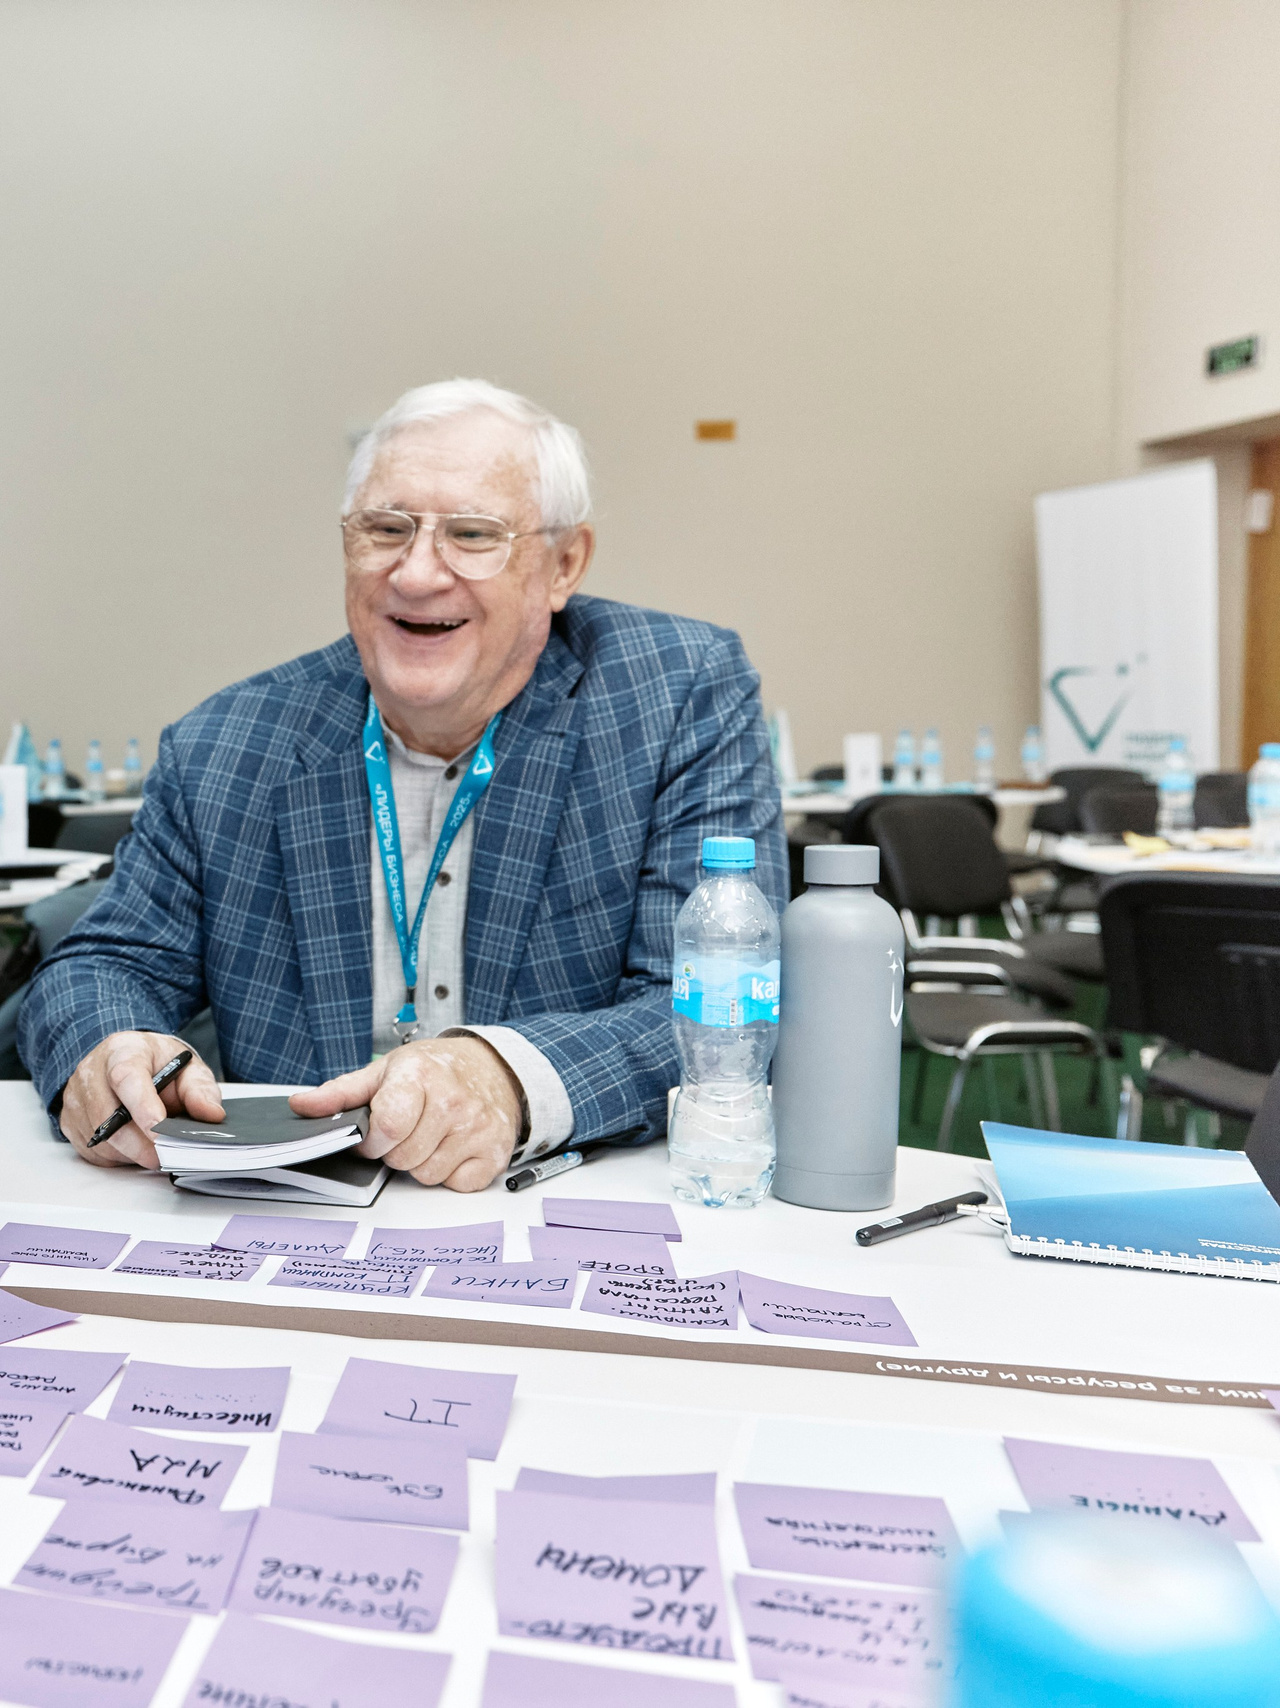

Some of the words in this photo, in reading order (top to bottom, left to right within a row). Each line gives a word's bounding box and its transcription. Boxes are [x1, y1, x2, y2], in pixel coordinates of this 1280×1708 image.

[375, 783, 395, 852] «ЛИДЕРЫ
[385, 852, 404, 923] БИЗНЕСА
[246, 1239, 345, 1255] ДИЛЕРЫ
[282, 1266, 367, 1280] КОМПАНИИ
[290, 1280, 410, 1294] КРУПНЫЕ
[451, 1275, 569, 1292] БАНКИ
[874, 1360, 990, 1380] другие)
[996, 1370, 1019, 1383] и
[1026, 1373, 1158, 1392] ресурсы
[1164, 1383, 1202, 1396] за
[130, 1403, 273, 1428] Инвестиции
[383, 1398, 472, 1428] IT
[49, 1465, 206, 1506] Финансовый
